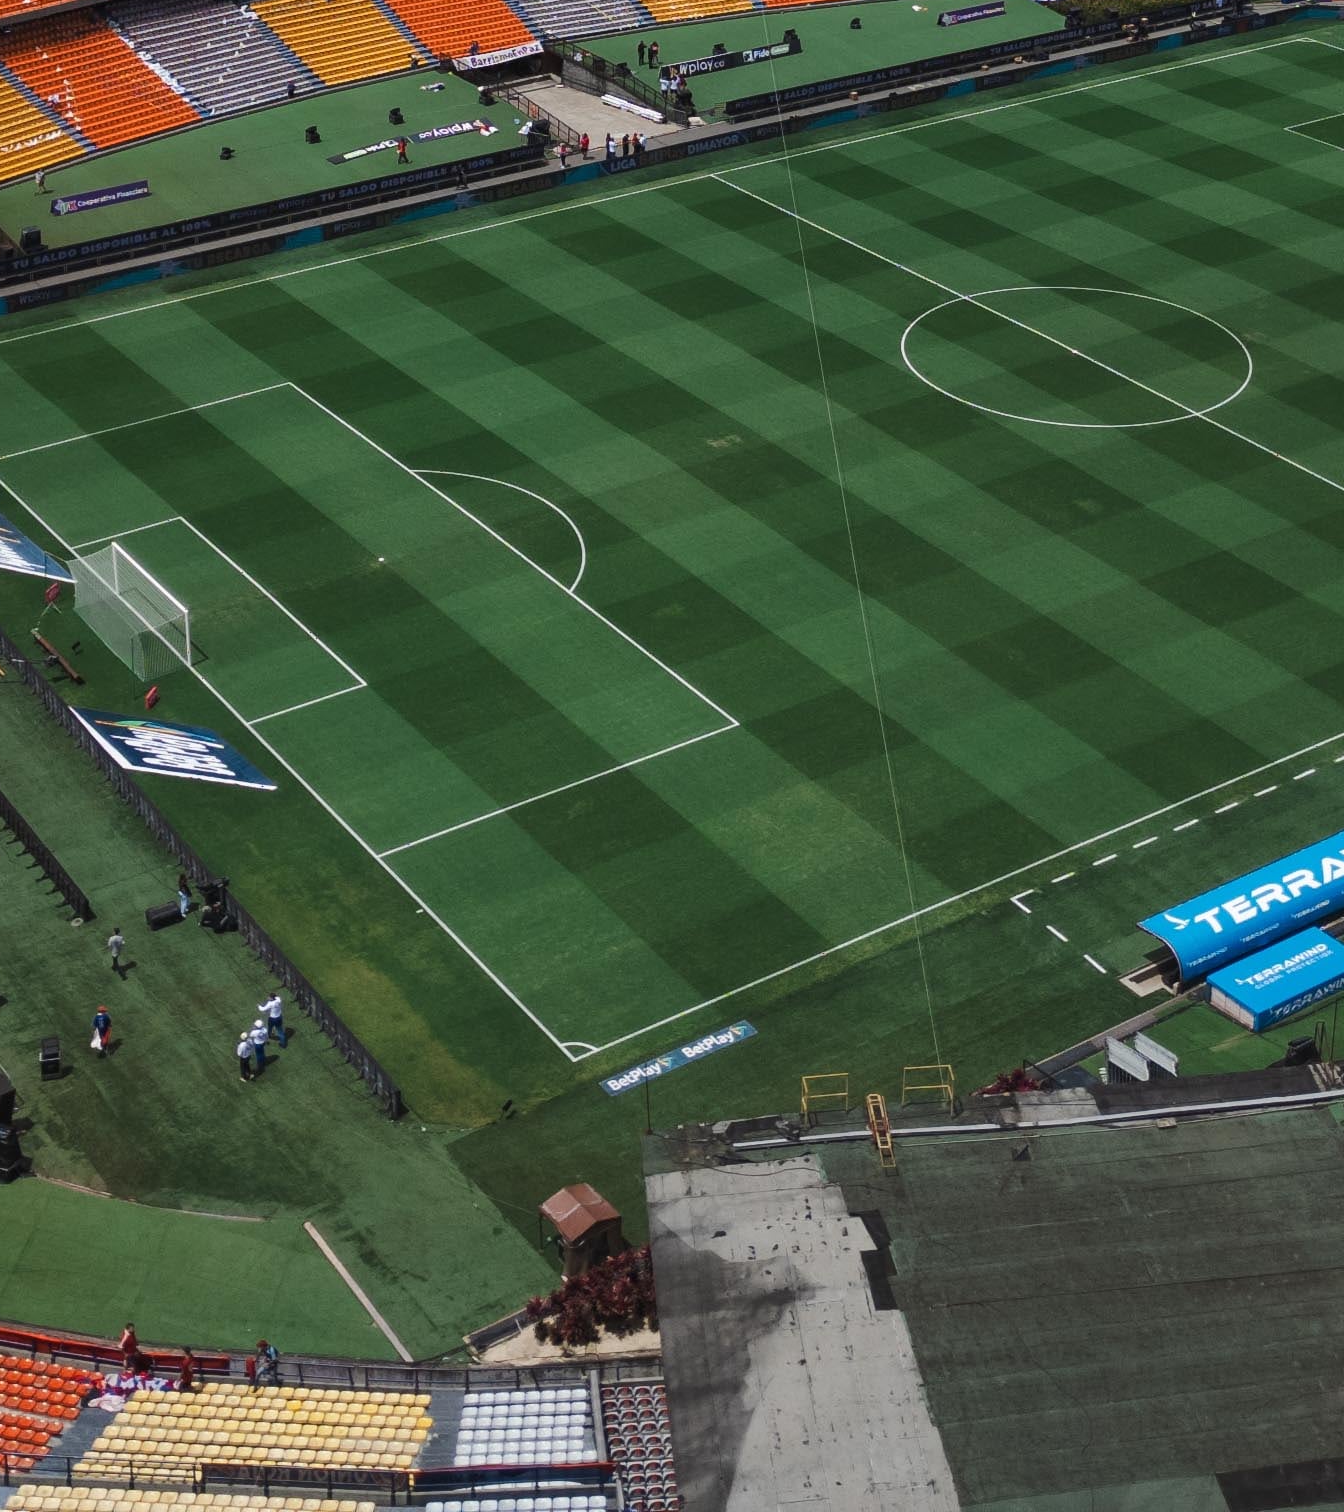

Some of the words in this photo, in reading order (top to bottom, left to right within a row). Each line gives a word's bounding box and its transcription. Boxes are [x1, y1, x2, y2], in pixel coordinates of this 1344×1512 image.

[610, 159, 637, 173] LIGA
[687, 134, 740, 155] DIMAYOR
[320, 191, 336, 202] TU
[338, 182, 377, 199] SALDO
[380, 168, 447, 190] DISPONIBLE
[12, 258, 30, 270] TU
[33, 248, 77, 267] SALDO
[81, 232, 157, 255] DISPONIBLE
[162, 227, 177, 238] AL
[1244, 943, 1329, 986] TERRAWIND
[681, 1031, 735, 1058] BetPlay
[606, 1062, 662, 1091] BetPlay
